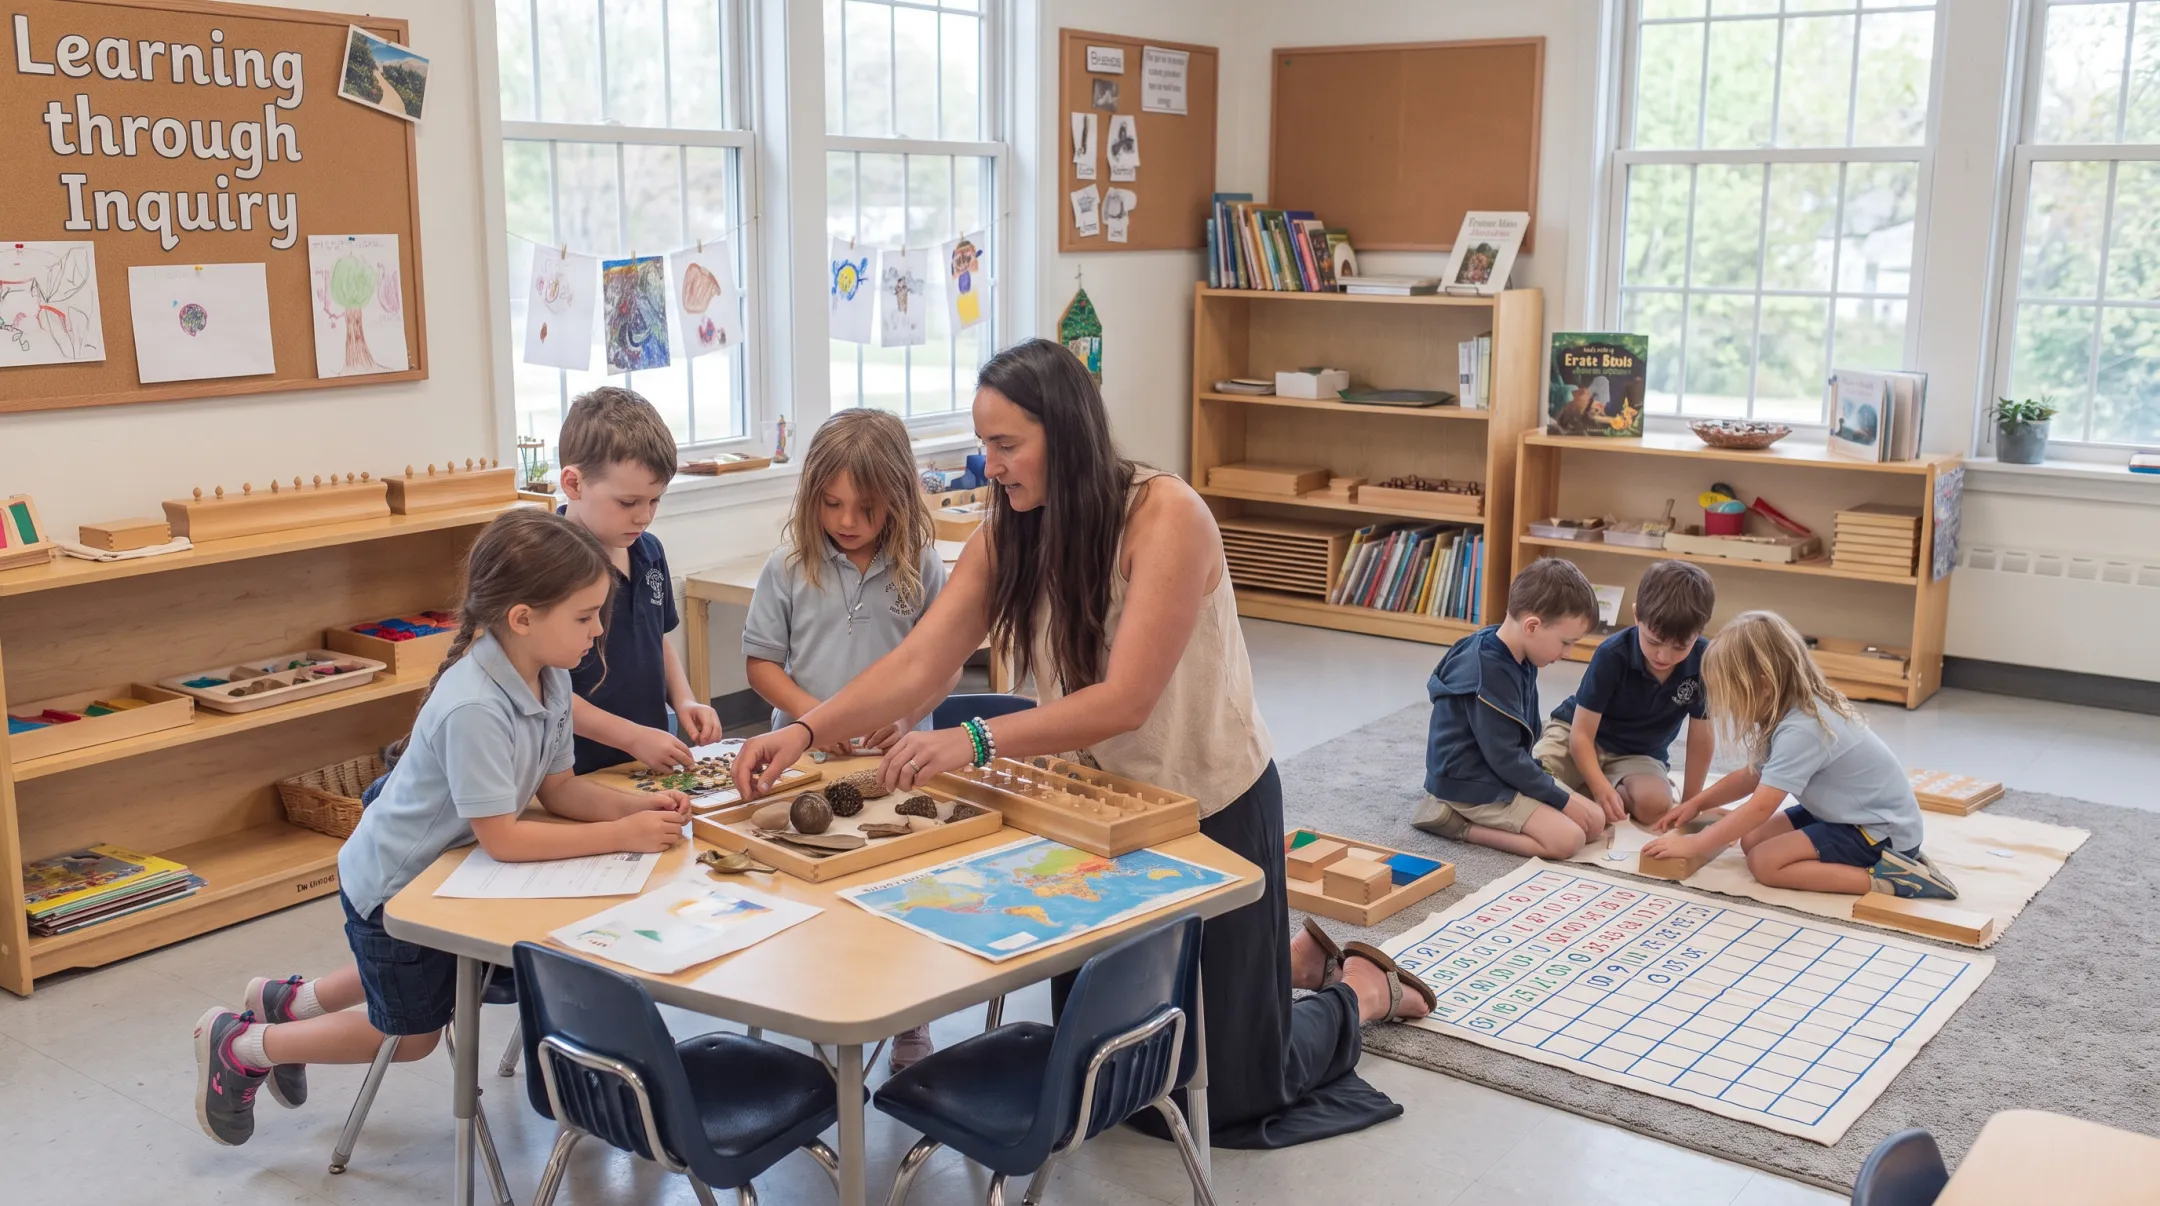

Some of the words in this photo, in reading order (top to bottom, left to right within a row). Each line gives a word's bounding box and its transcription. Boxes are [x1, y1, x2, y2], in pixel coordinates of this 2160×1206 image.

[12, 14, 305, 109] Learning
[43, 94, 303, 179] through
[60, 173, 299, 252] Inquiry
